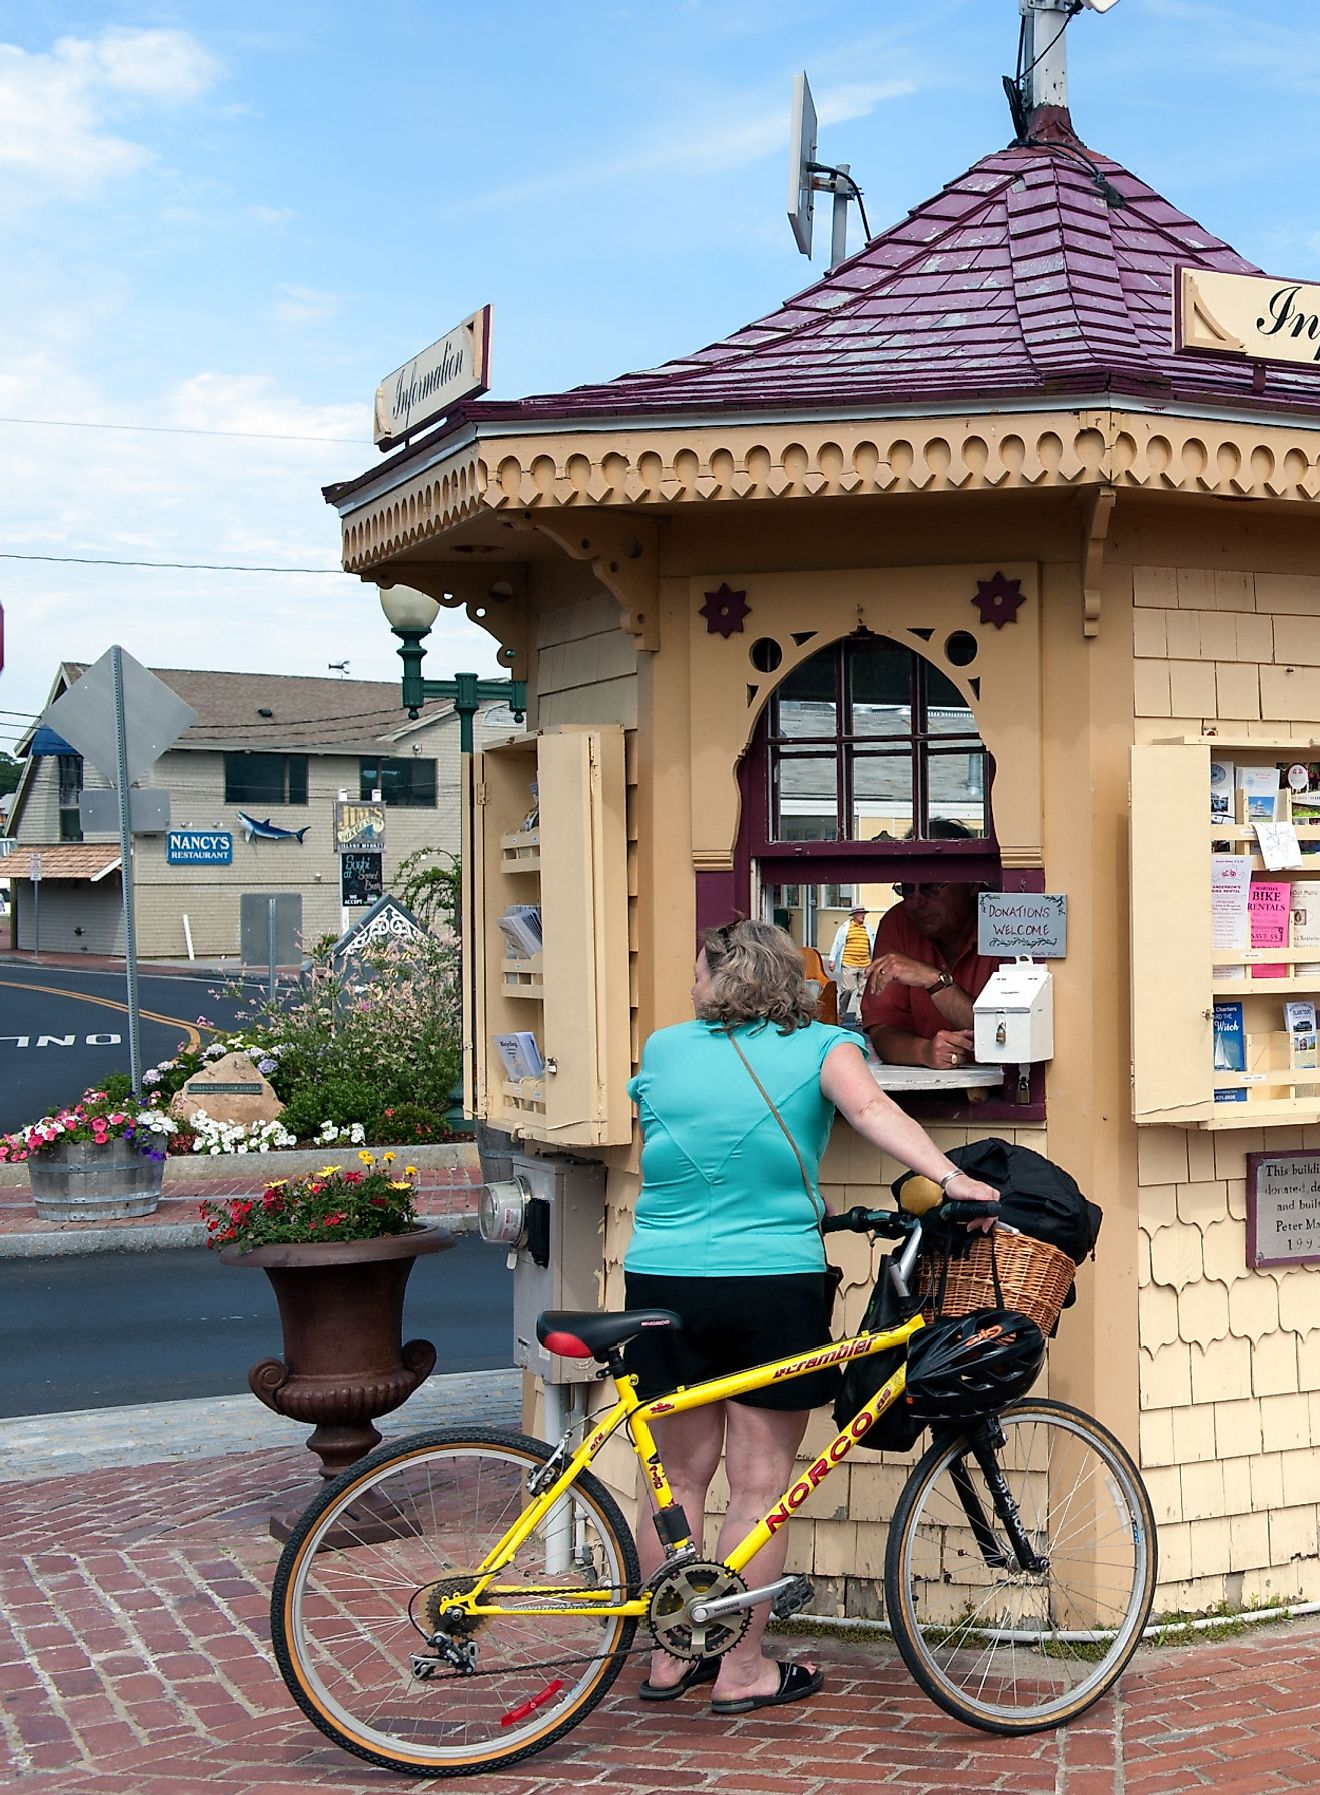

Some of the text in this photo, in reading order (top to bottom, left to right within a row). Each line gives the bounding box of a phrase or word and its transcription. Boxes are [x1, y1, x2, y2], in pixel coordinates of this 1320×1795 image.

[392, 340, 464, 428] Information
[339, 805, 383, 831] JIM'S
[170, 834, 230, 850] NANCY'S
[171, 851, 229, 859] RESTAURANT
[1252, 891, 1281, 901] BIKE
[988, 904, 1050, 919] DONATIONS
[1247, 902, 1286, 911] RENTALS
[992, 923, 1050, 936] WELCOME
[1214, 1019, 1240, 1032] Witch
[0, 1033, 122, 1048] ONL
[1265, 1164, 1289, 1177] This
[1276, 1199, 1295, 1212] and
[1275, 1219, 1303, 1233] Peter
[765, 1411, 873, 1535] NORCO
